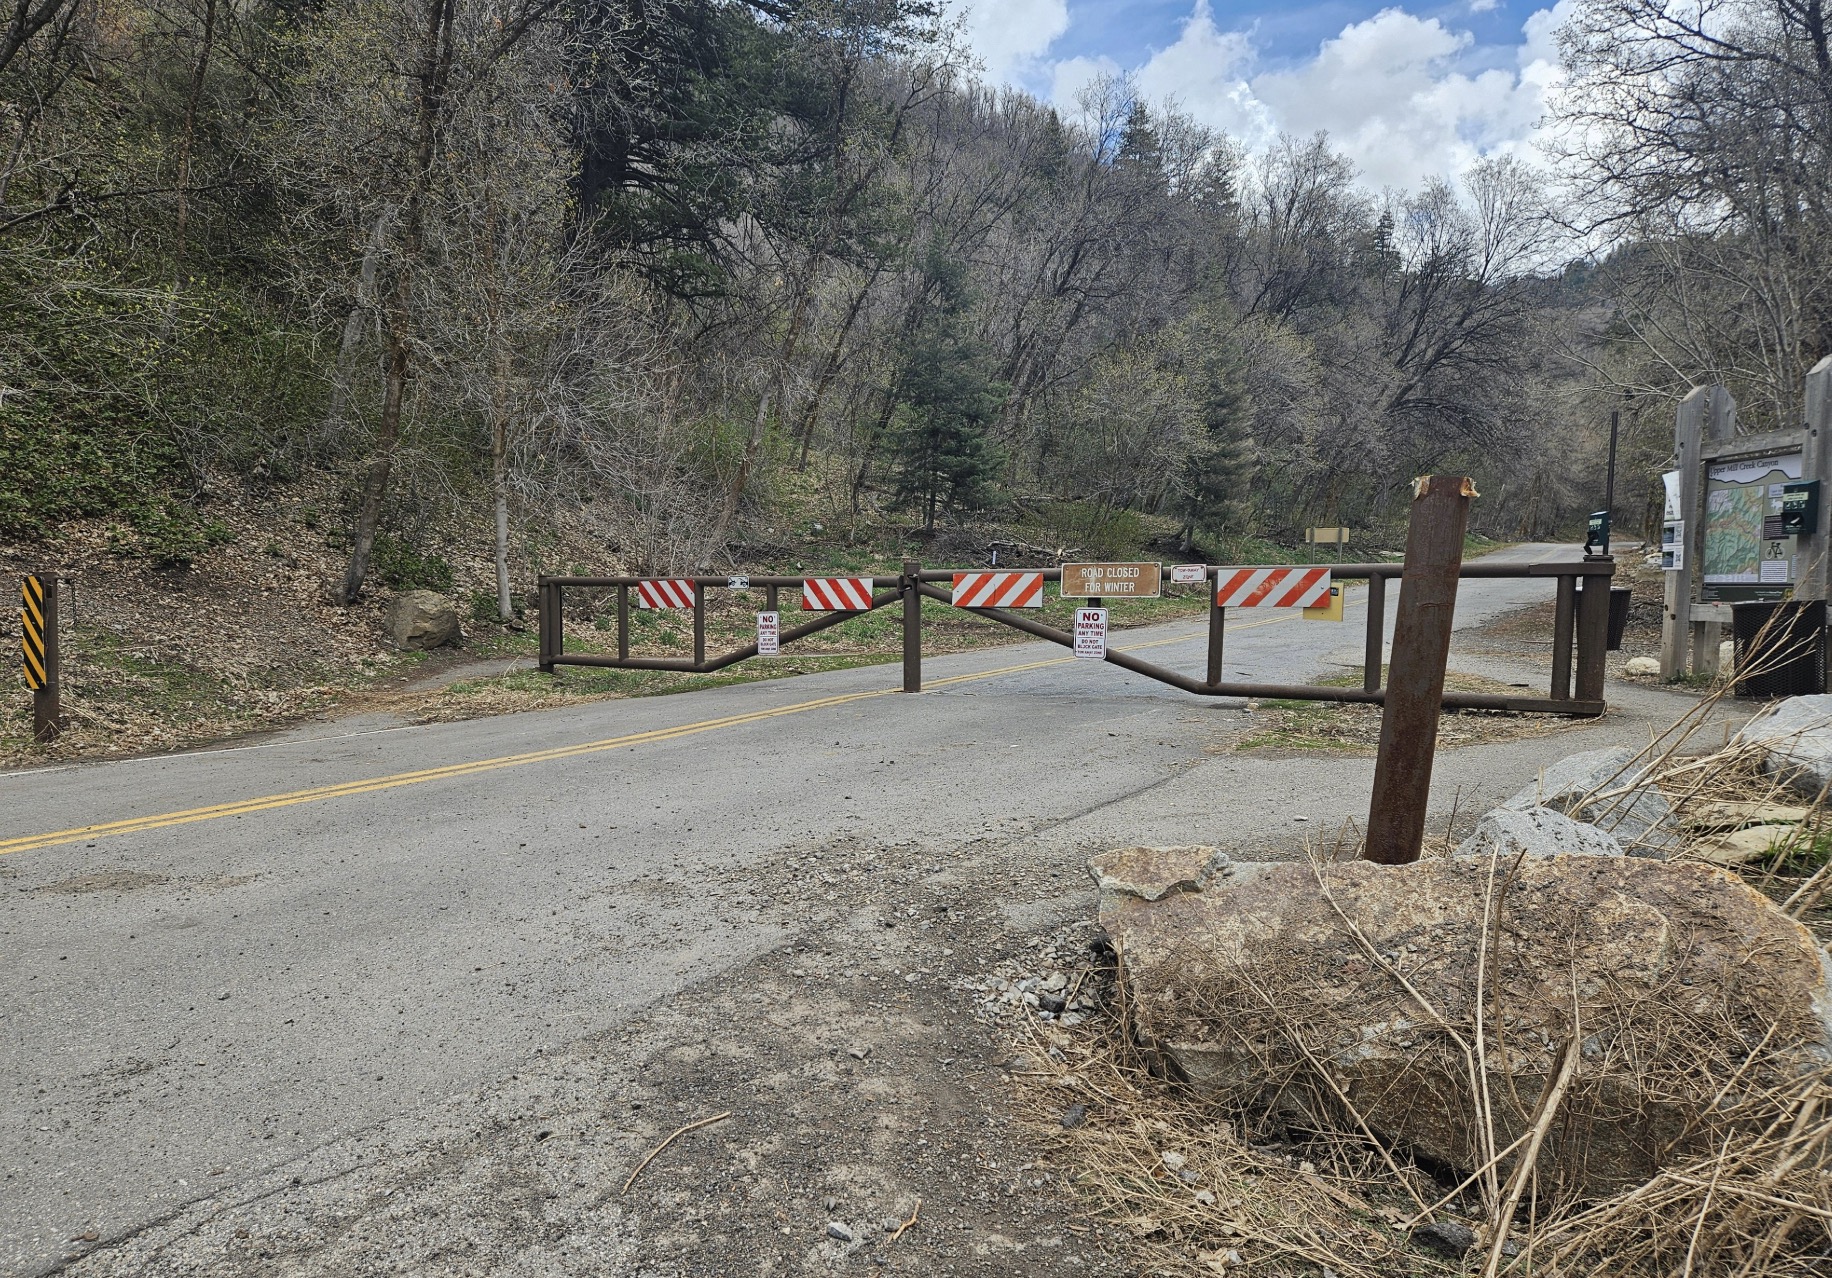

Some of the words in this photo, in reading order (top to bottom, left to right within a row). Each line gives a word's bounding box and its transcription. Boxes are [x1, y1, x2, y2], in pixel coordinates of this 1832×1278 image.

[1710, 467, 1725, 477] Upper
[1727, 464, 1738, 472] Mill
[1739, 462, 1756, 471] Creek
[1757, 460, 1779, 469] Canyon
[1081, 568, 1104, 578] ROAD
[1107, 567, 1140, 578] CLOSED
[1085, 583, 1101, 592] FOR
[1104, 582, 1135, 593] WINTER
[1082, 612, 1100, 621] NO
